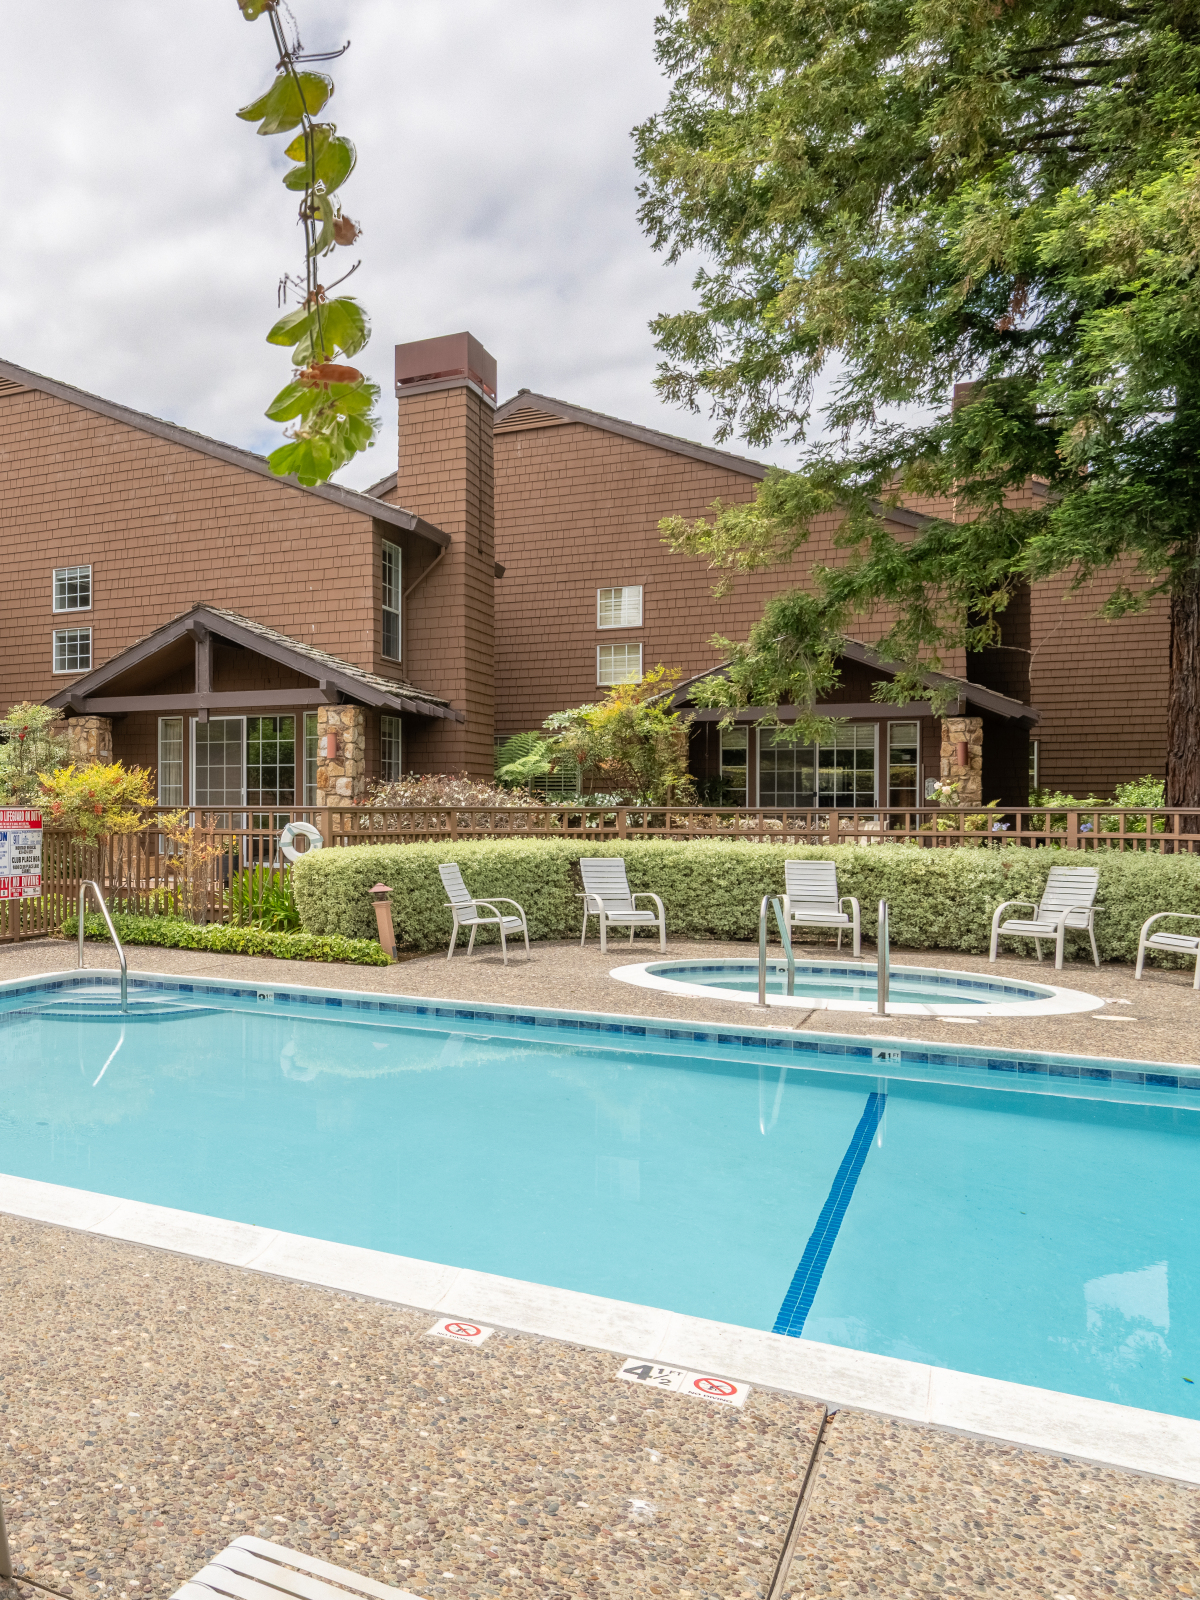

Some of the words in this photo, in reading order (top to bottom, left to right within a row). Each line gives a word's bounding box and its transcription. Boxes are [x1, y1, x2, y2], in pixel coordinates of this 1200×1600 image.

[4, 811, 24, 822] LIFEGUARD
[25, 811, 30, 822] ON
[12, 877, 20, 887] NO
[22, 876, 39, 886] DIVING
[623, 1364, 654, 1380] 4
[703, 1395, 733, 1403] DIVING
